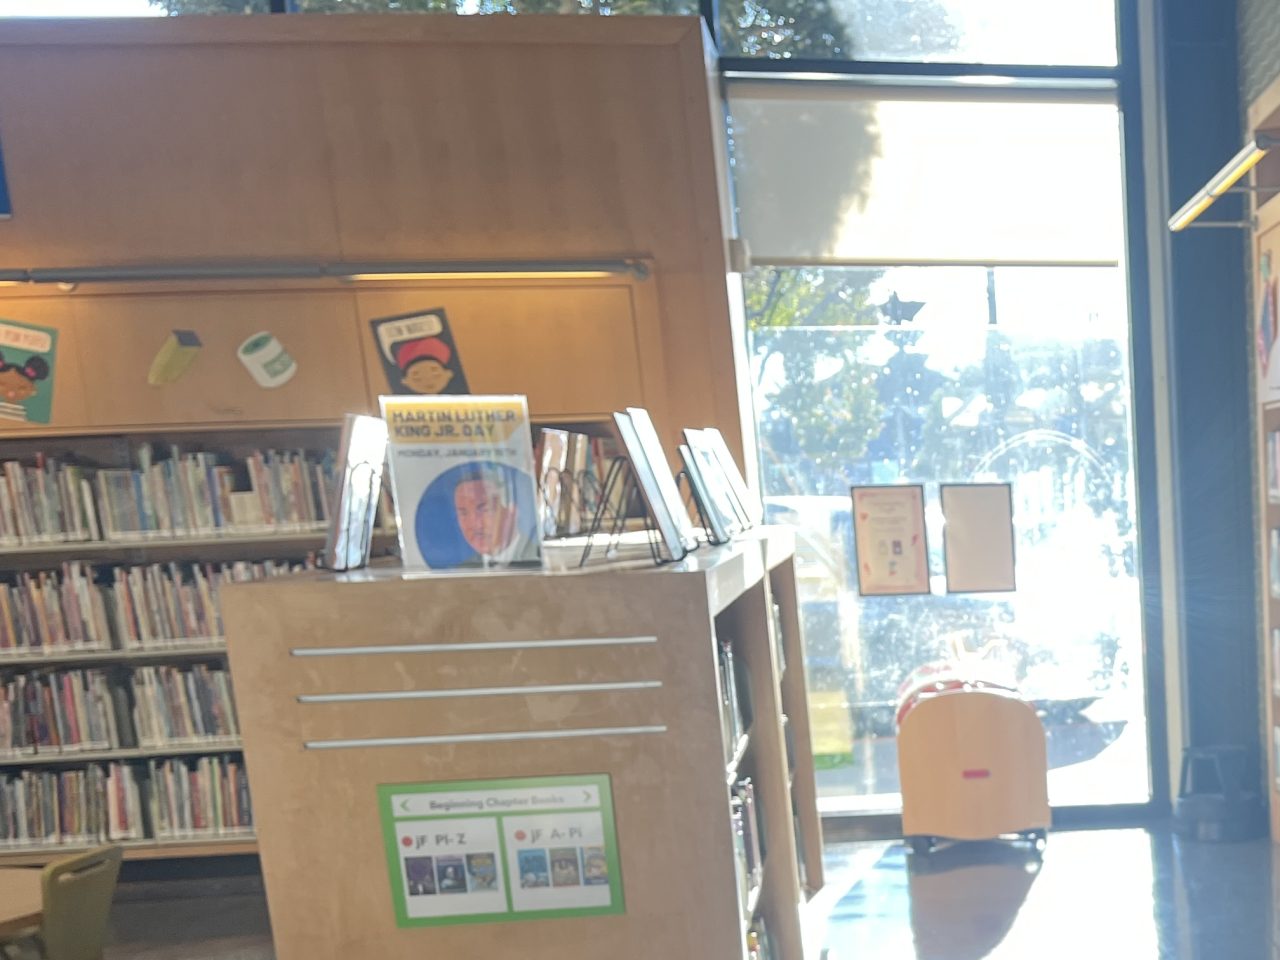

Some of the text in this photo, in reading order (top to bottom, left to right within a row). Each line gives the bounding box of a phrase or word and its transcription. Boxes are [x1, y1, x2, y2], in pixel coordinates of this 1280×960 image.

[392, 409, 516, 422] MARTIN LUTHER
[394, 424, 431, 437] KING
[462, 424, 494, 437] DAY
